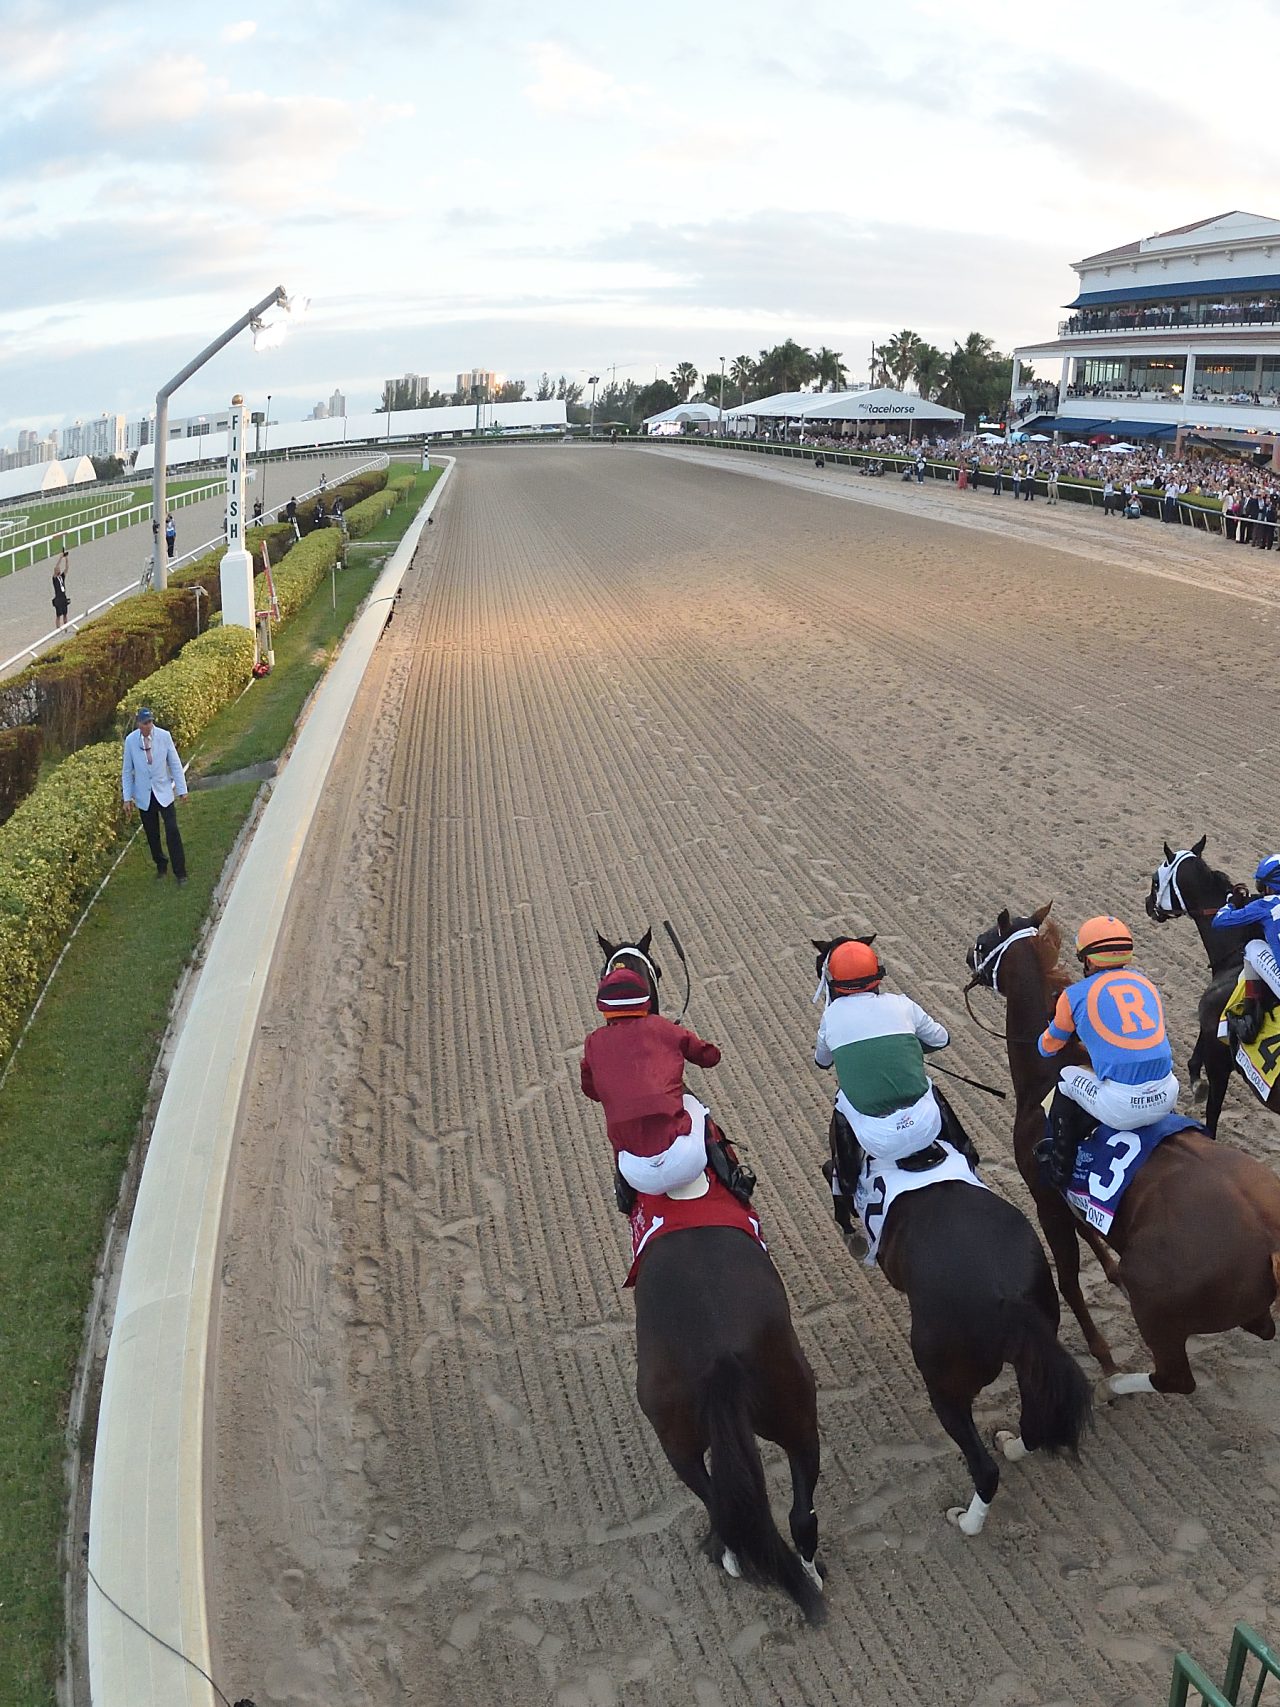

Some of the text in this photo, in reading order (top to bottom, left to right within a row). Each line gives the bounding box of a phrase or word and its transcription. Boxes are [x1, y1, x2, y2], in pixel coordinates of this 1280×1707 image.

[858, 403, 915, 414] myRacehorse
[229, 414, 239, 539] FINISH
[1257, 949, 1276, 967] JEFF
[1107, 984, 1156, 1034] R
[1250, 1071, 1266, 1092] GOLD
[1130, 1096, 1144, 1105] JEFF
[1146, 1091, 1168, 1104] RUBY'S
[896, 1120, 915, 1132] PACO
[1088, 1130, 1142, 1202] 3
[1088, 1207, 1105, 1227] ONE
